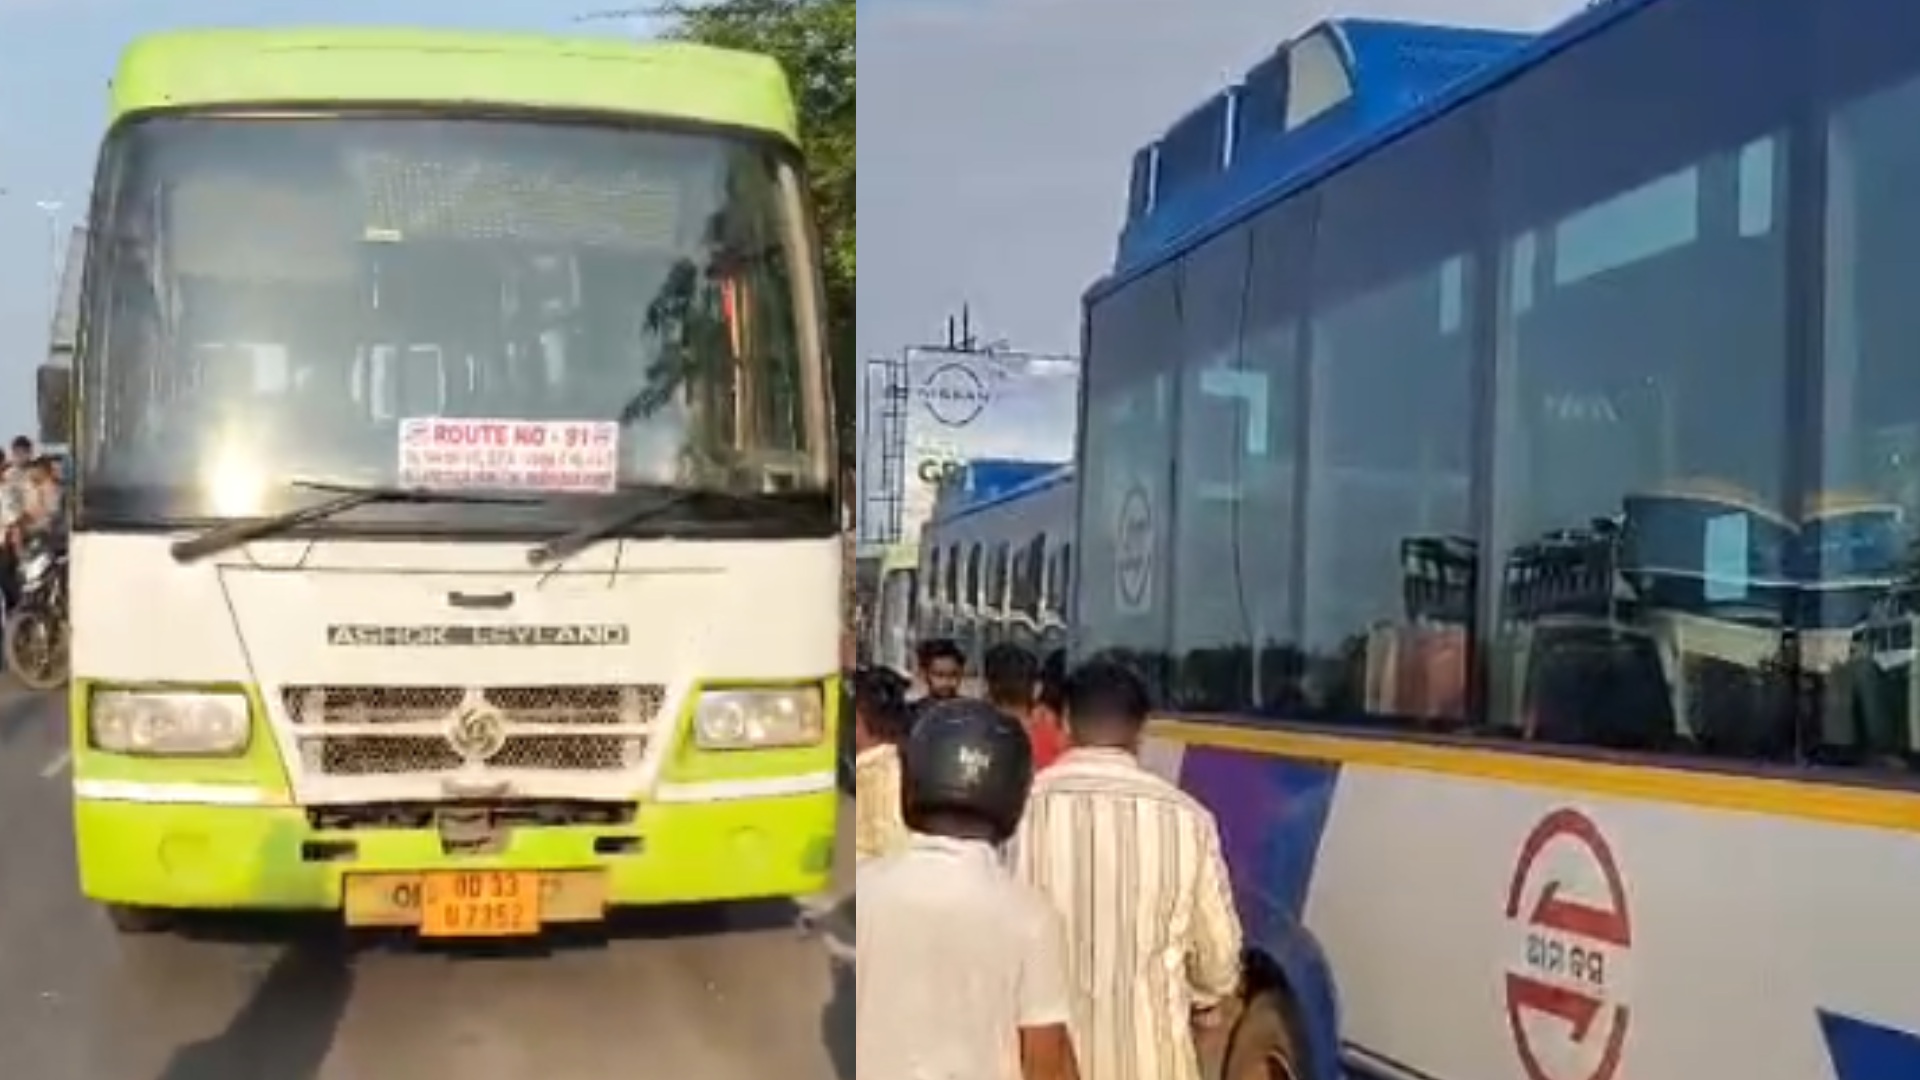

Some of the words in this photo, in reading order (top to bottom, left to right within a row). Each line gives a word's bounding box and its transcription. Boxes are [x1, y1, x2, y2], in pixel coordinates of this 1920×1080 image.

[433, 424, 508, 445] ROUTE
[514, 426, 545, 446] NO
[332, 625, 448, 644] ASHOK
[472, 625, 625, 644] LEYLAND
